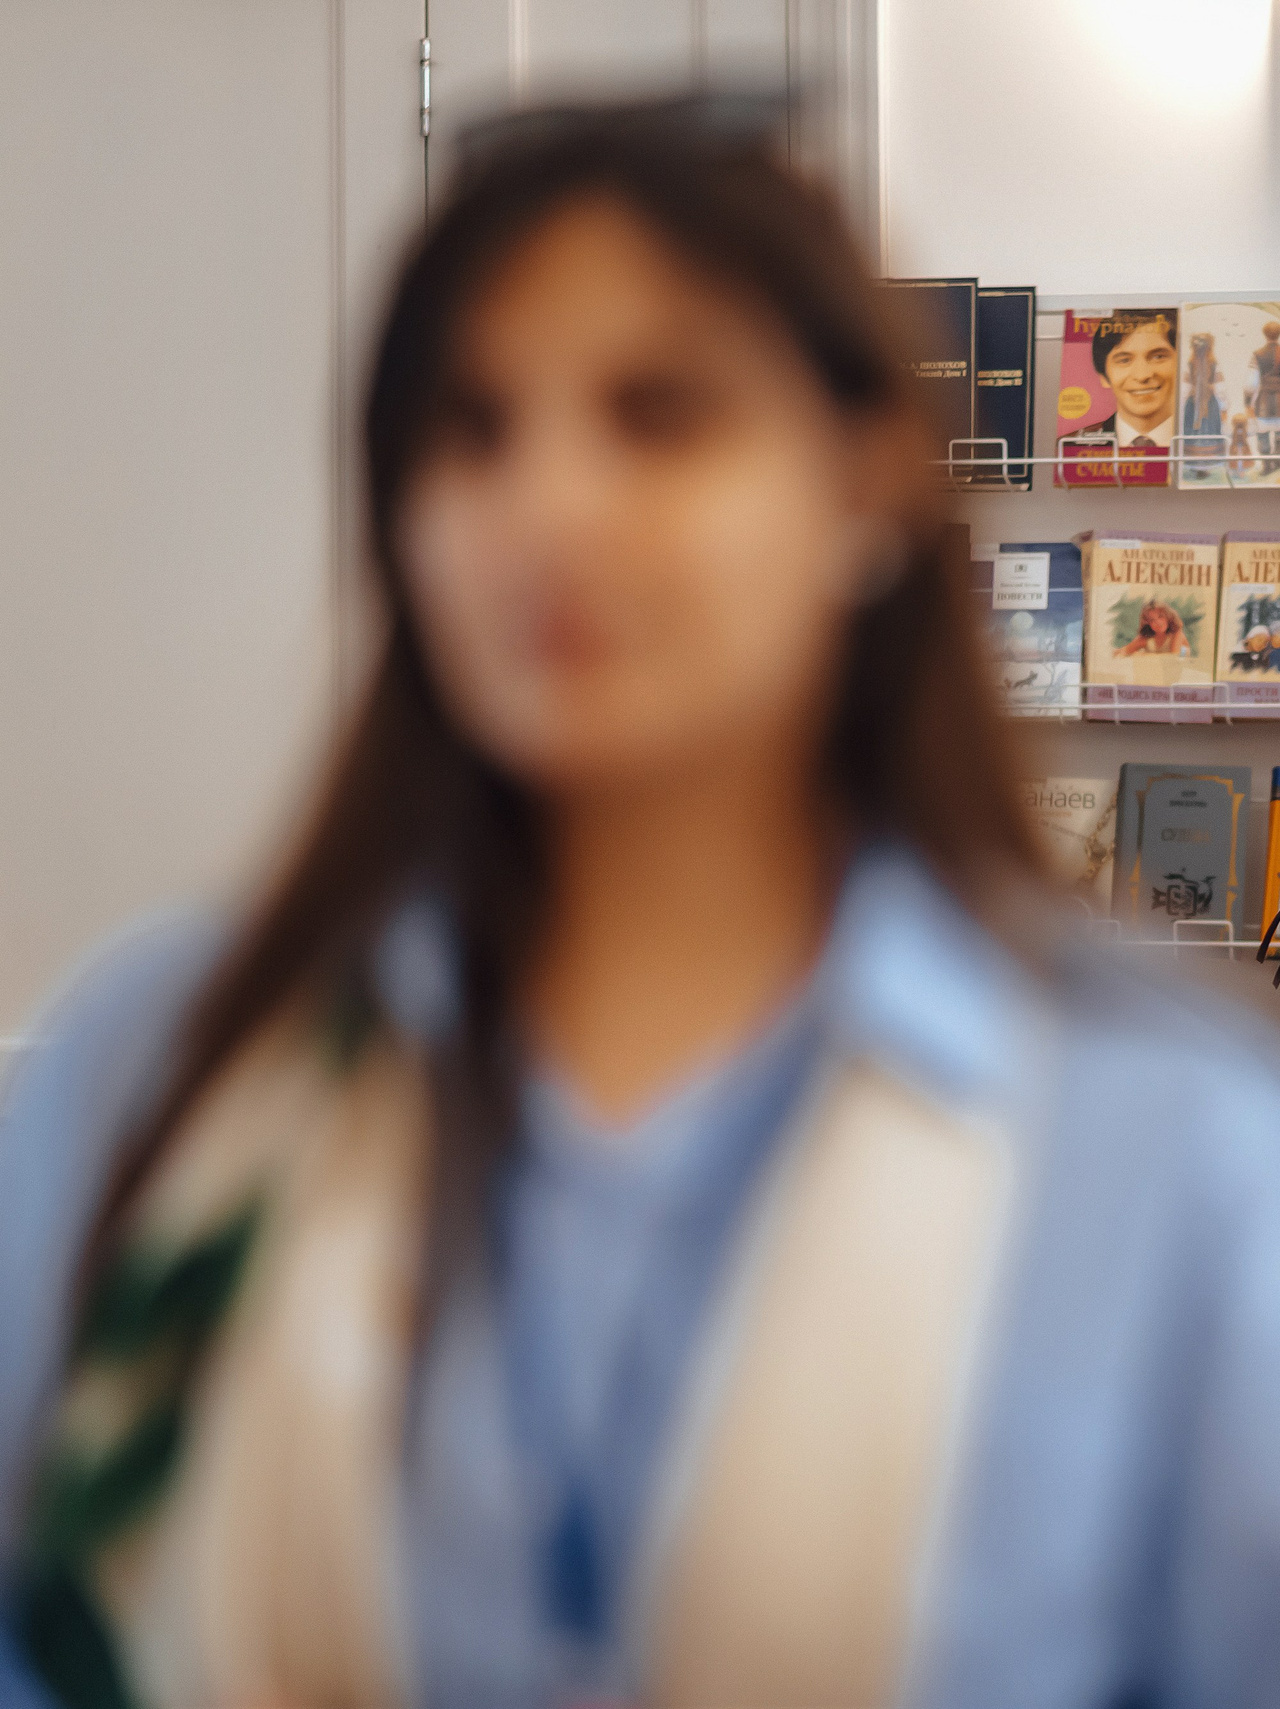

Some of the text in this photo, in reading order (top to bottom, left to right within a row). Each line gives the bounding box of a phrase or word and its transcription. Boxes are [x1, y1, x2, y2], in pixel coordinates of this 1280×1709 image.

[1121, 548, 1195, 562] АНАТОЛИЙ
[1102, 559, 1211, 587] АЛЕКСИН
[1025, 791, 1095, 809] анаев
